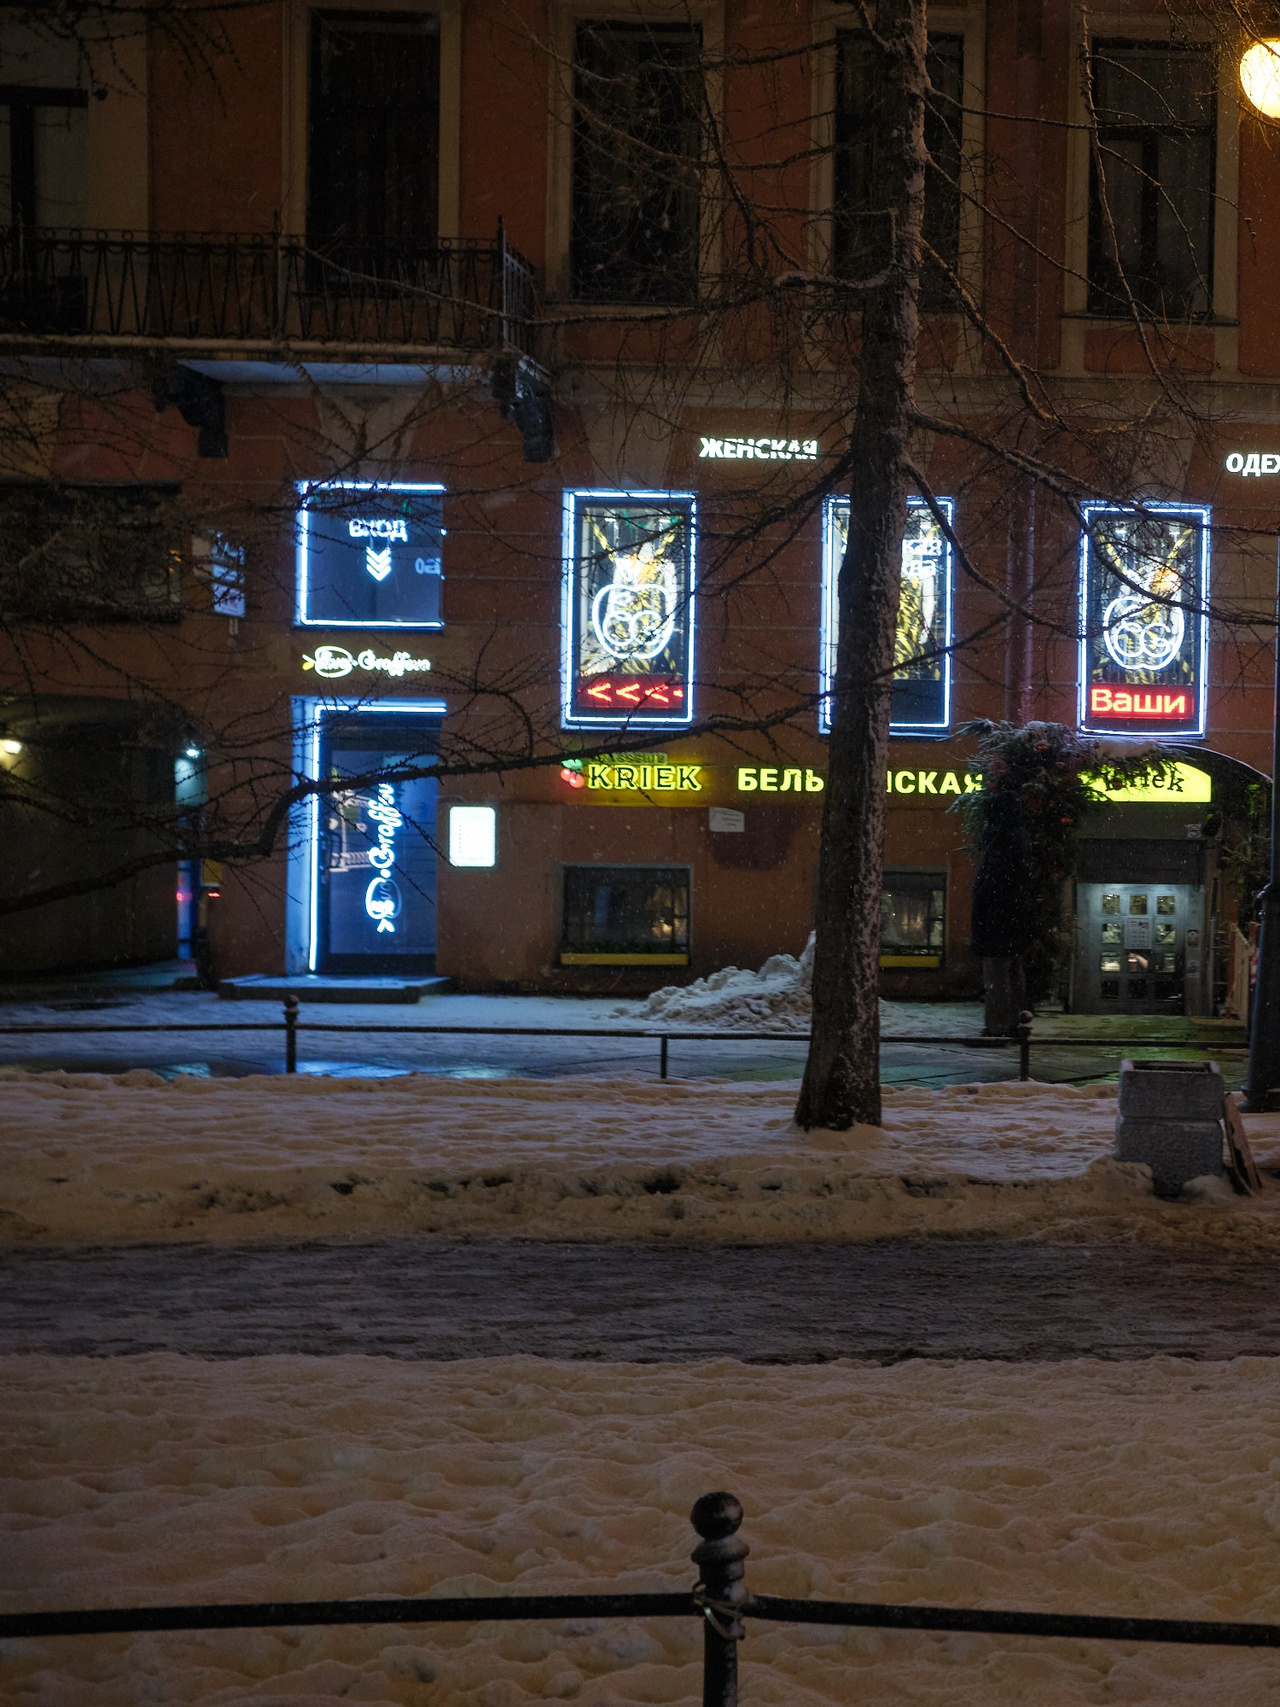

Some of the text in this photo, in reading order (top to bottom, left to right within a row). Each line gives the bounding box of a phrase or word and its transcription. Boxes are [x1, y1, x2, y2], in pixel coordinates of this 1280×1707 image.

[699, 437, 817, 459] ЖЕНСКАЯ
[349, 518, 408, 541] ВХОД
[1091, 688, 1186, 714] Ваши
[587, 764, 702, 791] KRIEK
[738, 768, 982, 794] БЕЛЬСКАЯ
